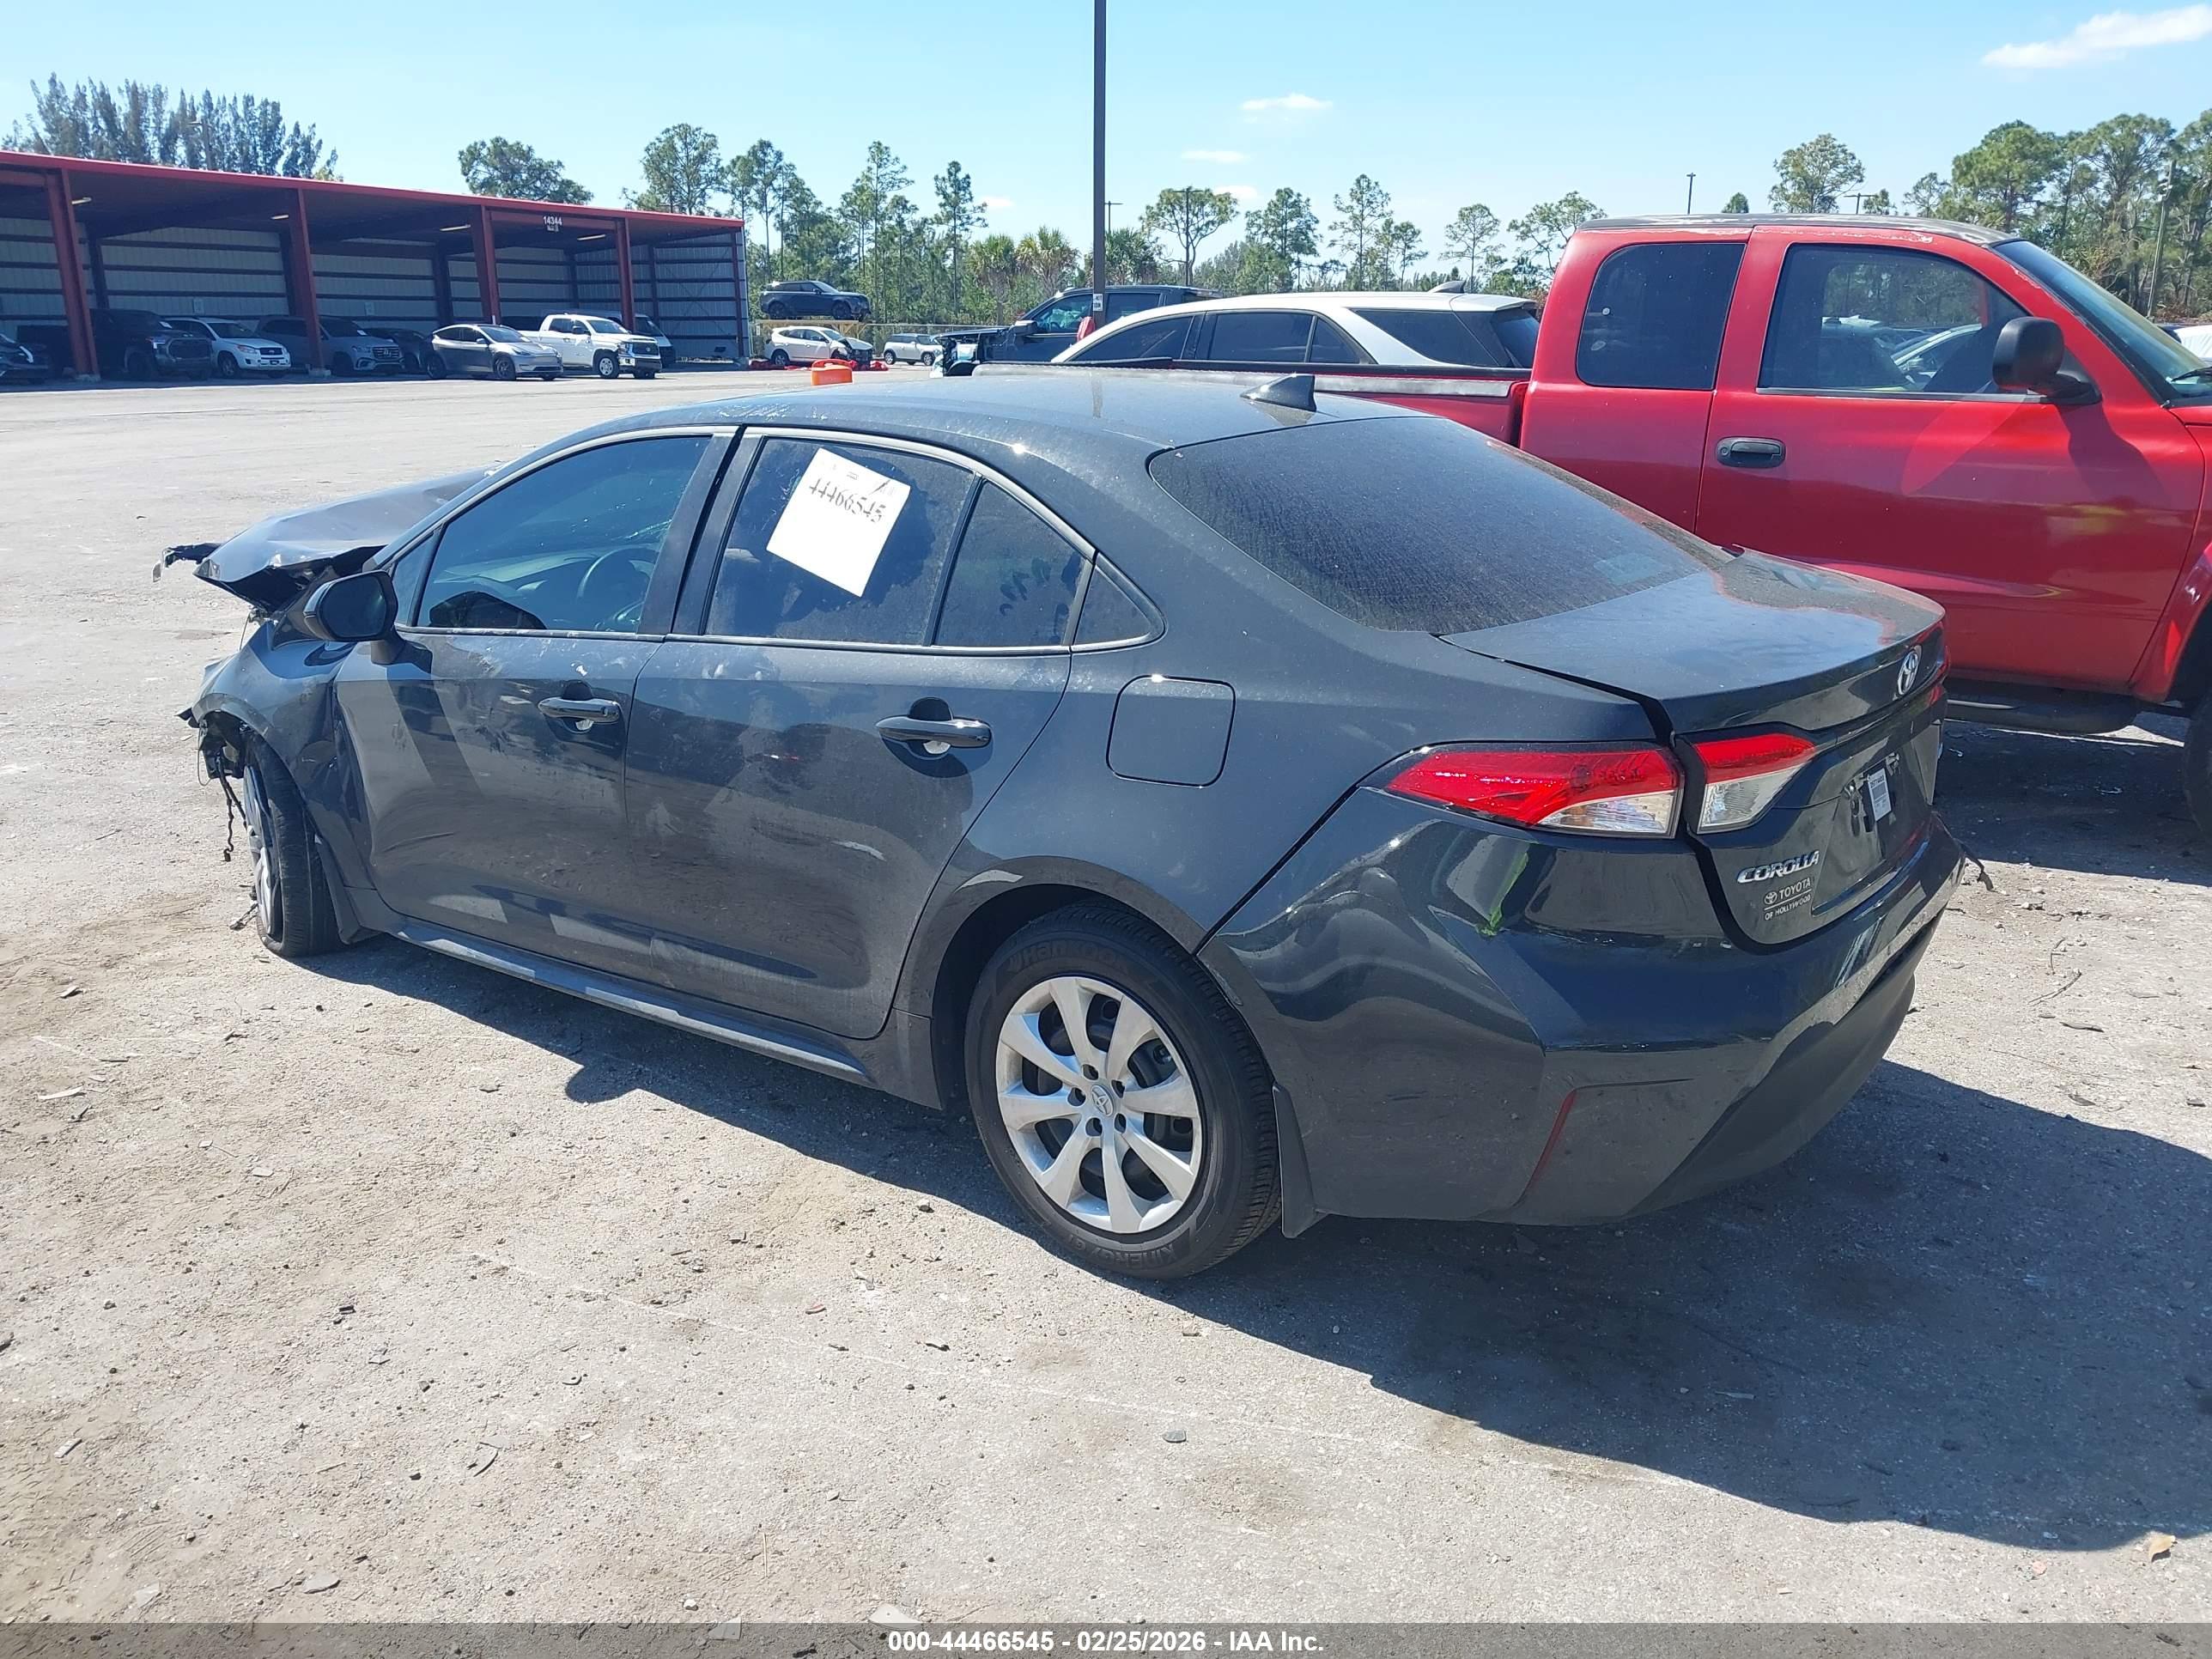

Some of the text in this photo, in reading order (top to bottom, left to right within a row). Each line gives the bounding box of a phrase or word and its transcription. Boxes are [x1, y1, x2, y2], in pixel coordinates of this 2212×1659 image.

[543, 216, 562, 226] 14344
[809, 477, 887, 523] 44466545
[1737, 849, 1820, 884] COROLLA
[1778, 877, 1811, 900] TOYOTA
[1764, 894, 1811, 921] OF HOLLYWOOD
